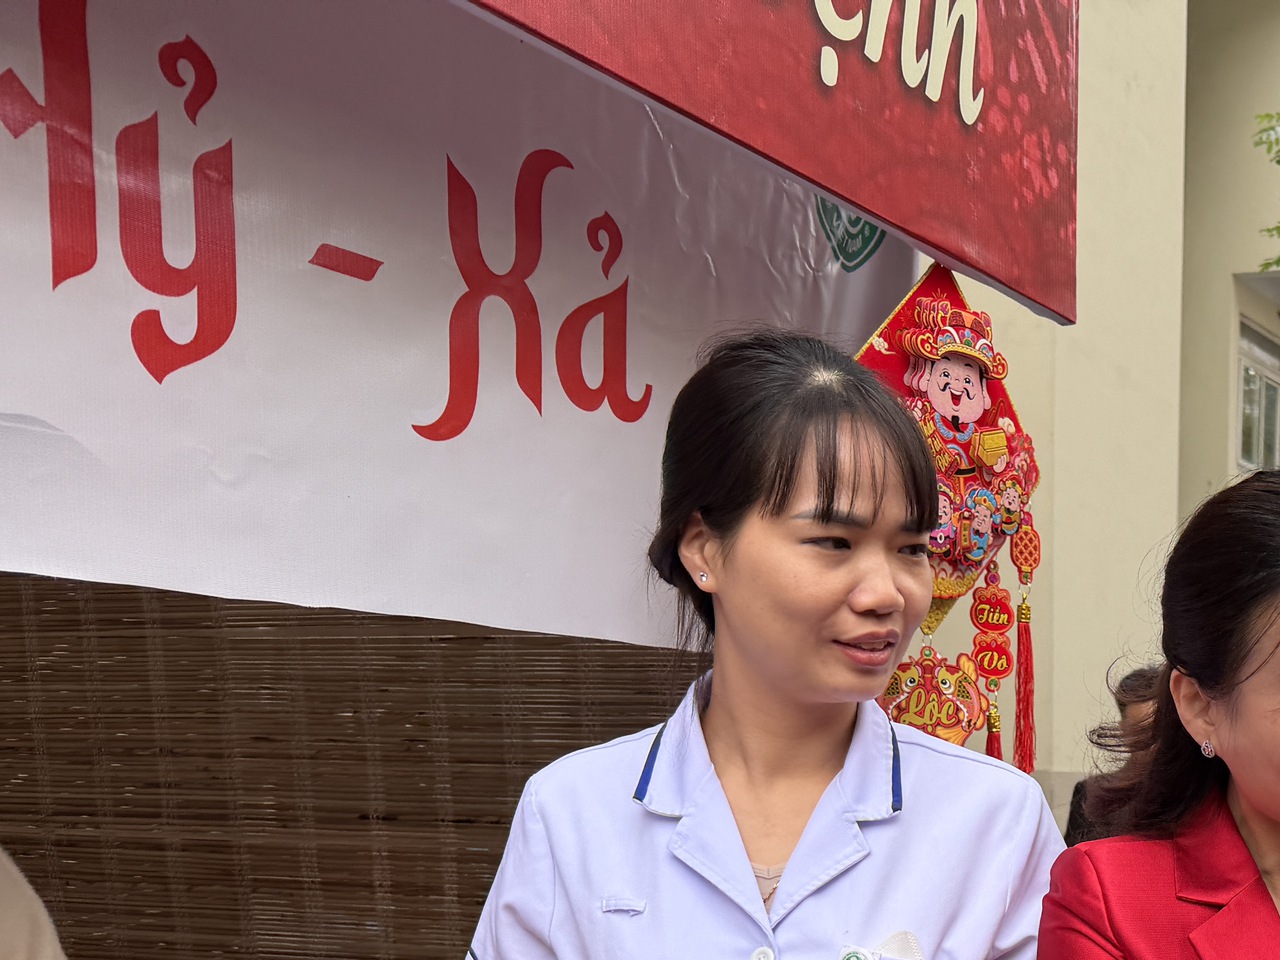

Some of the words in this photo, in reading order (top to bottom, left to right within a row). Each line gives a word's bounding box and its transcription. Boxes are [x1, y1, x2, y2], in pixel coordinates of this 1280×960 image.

[412, 149, 653, 442] Xả
[976, 604, 1009, 625] Tiền
[977, 650, 1008, 671] Vô
[902, 688, 958, 733] Lộc
